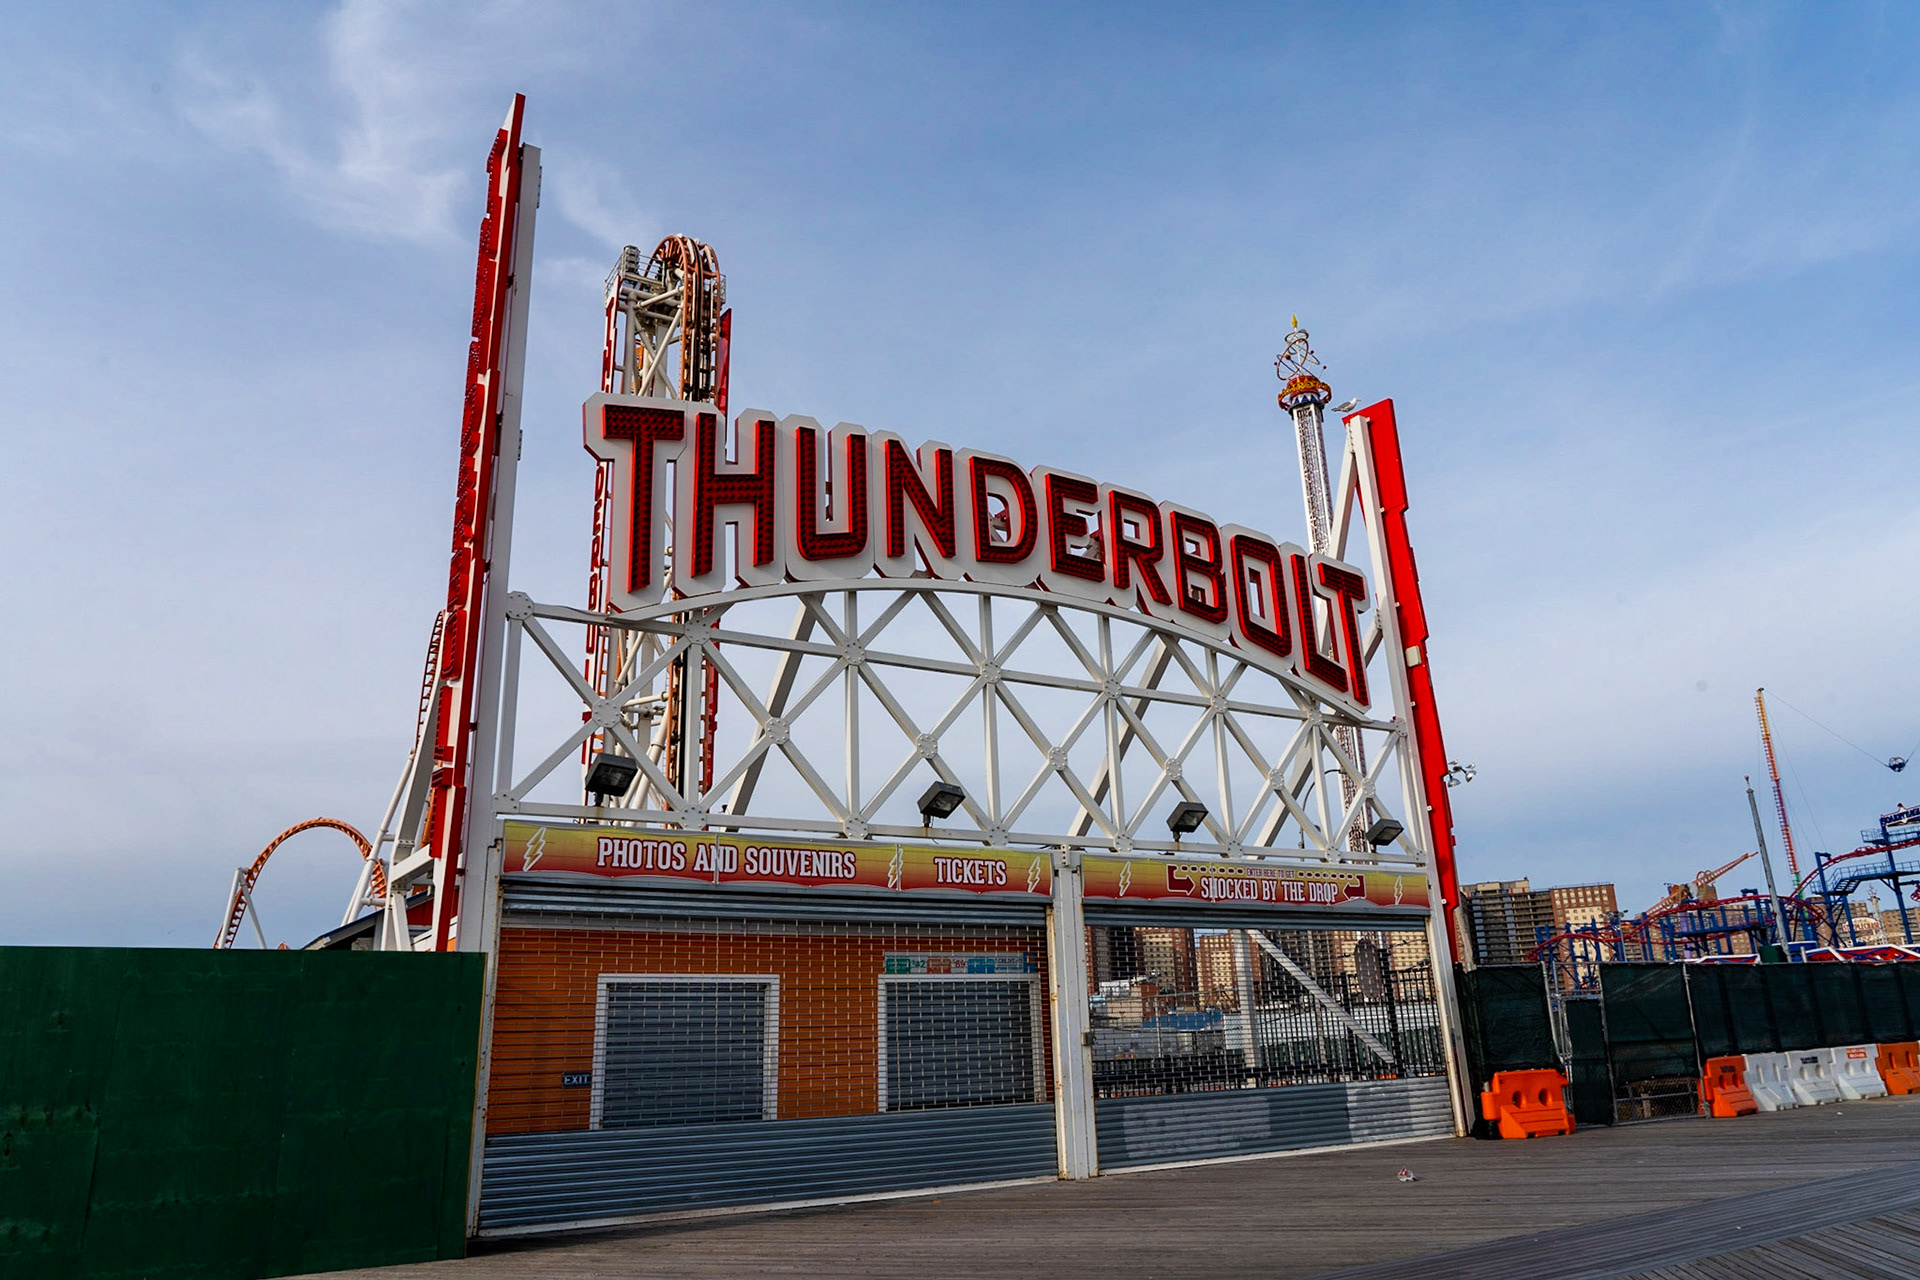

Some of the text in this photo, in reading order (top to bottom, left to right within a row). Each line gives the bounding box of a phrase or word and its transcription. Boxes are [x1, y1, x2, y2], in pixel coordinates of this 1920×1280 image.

[602, 404, 1369, 706] THUNDERBOLT
[597, 838, 856, 878] PHOTOS AND SOUVENIRS
[934, 857, 1007, 885] TICKETS
[1246, 867, 1295, 878] ENTER HERE TO GET
[1201, 877, 1338, 902] SHOCKED BY THE DROP
[564, 1074, 589, 1085] EXIT
